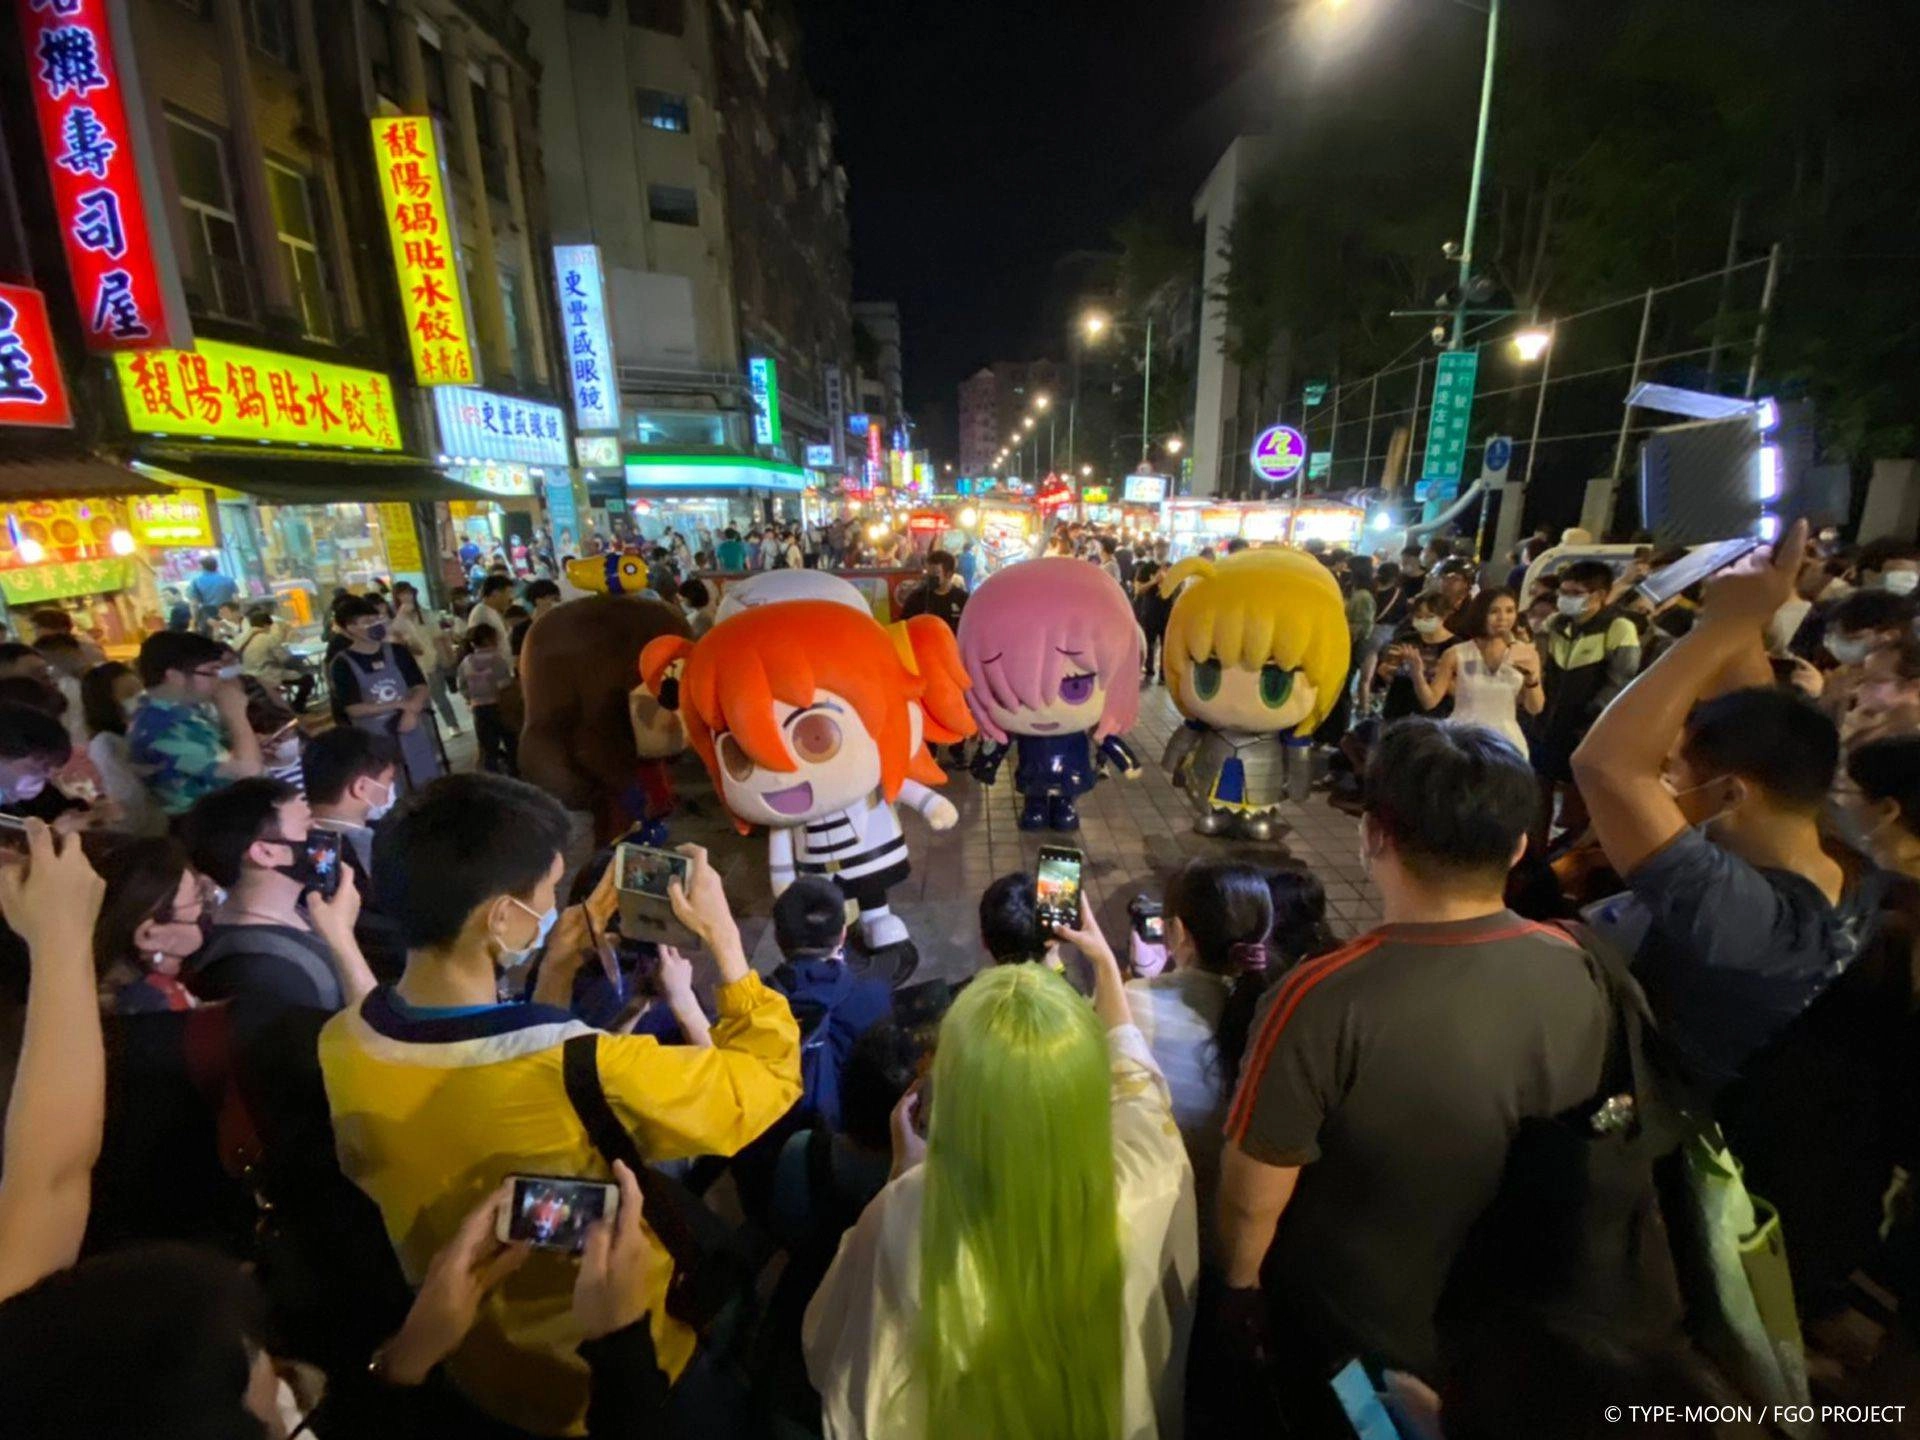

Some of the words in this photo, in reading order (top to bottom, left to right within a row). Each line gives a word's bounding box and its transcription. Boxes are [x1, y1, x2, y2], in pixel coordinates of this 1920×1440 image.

[31, 0, 151, 339] 攤壽司屋
[381, 120, 461, 343] 馥陽鍋貼水餃
[129, 350, 375, 437] 馥陽鍋貼水餃
[420, 347, 468, 380] 專賣店
[369, 376, 396, 448] 專賣店
